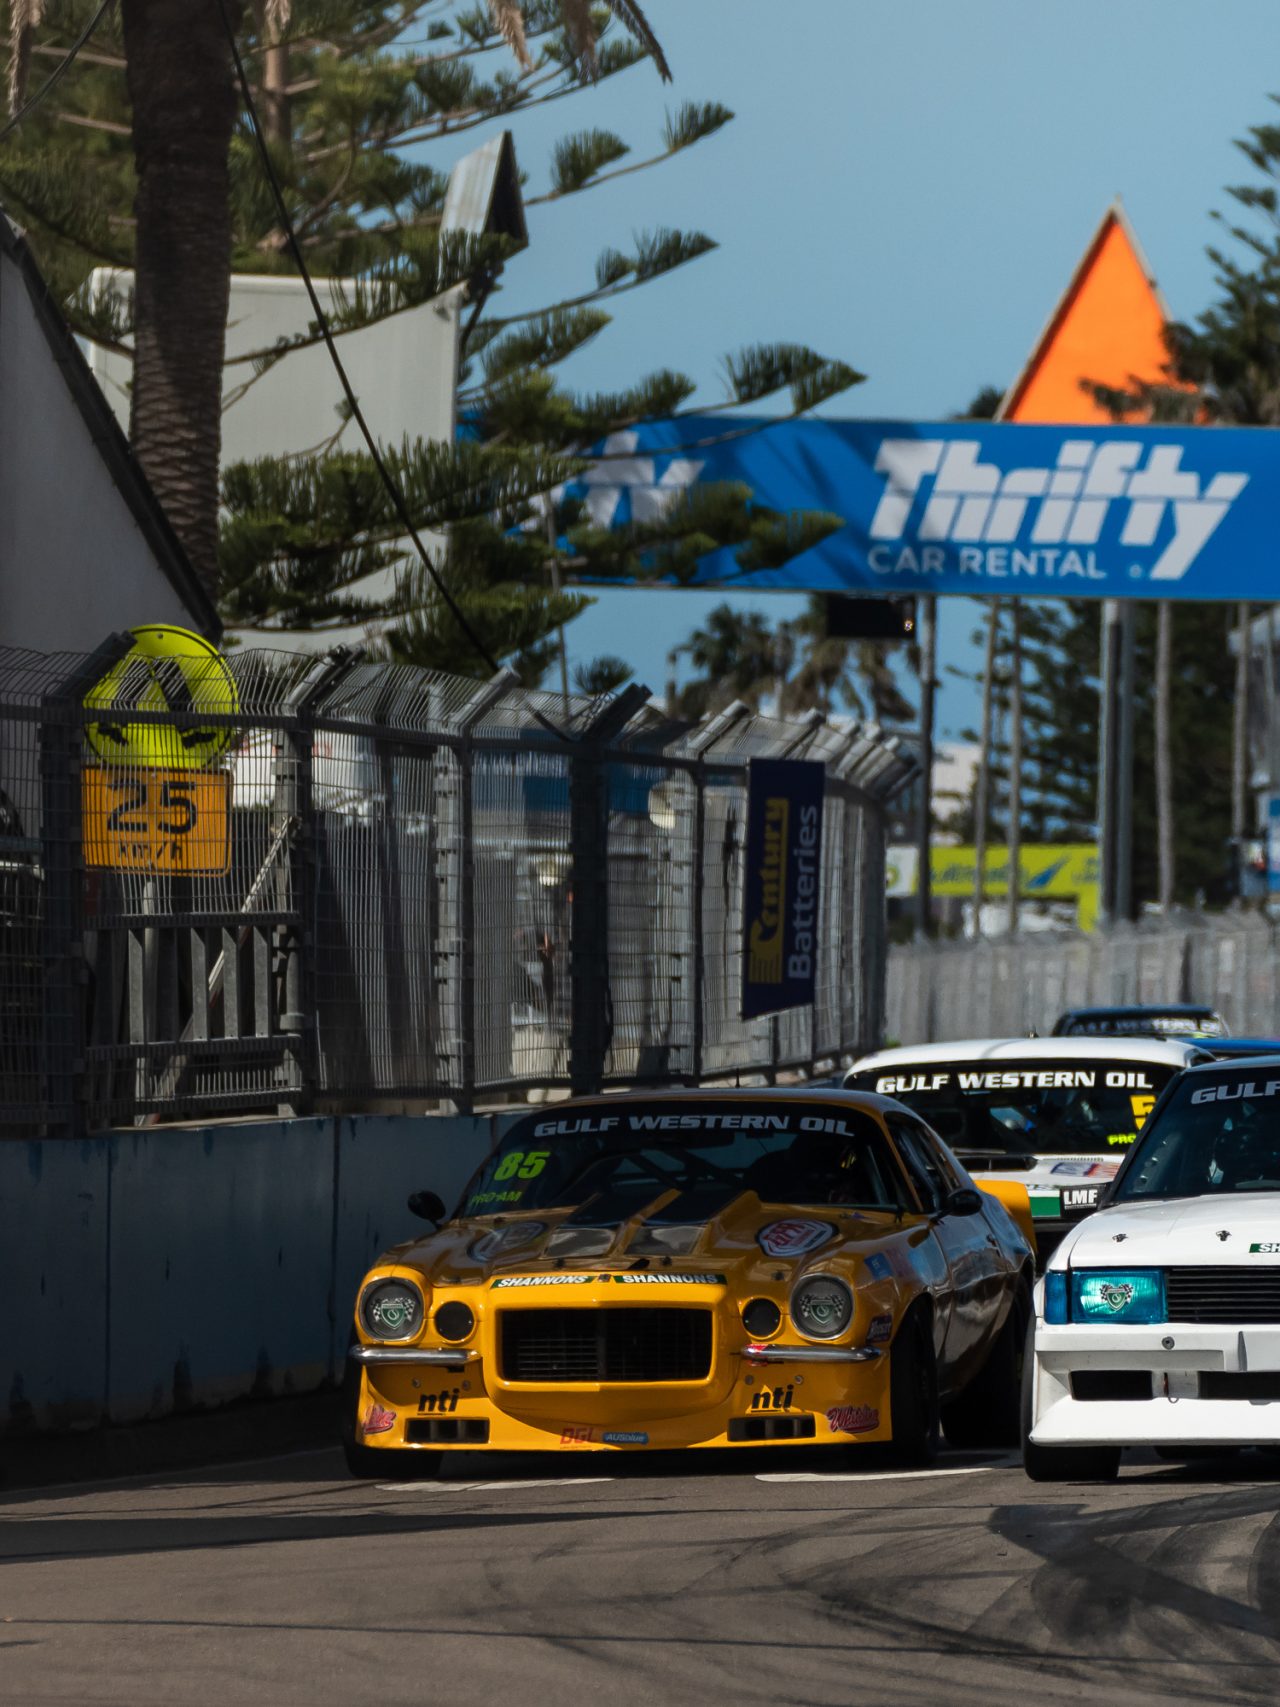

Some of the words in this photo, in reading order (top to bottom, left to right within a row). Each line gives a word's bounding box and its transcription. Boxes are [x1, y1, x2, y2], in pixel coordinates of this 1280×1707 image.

[869, 440, 1250, 580] Thrifty
[867, 546, 945, 575] CAR
[959, 546, 1107, 579] RENTAL
[107, 778, 198, 835] 25
[788, 804, 818, 979] Batteries
[875, 1074, 950, 1094] GULF
[958, 1071, 1096, 1089] WESTERN
[1105, 1071, 1153, 1089] OIL
[534, 1117, 620, 1138] GULF
[629, 1114, 790, 1131] WESTERN
[800, 1116, 855, 1137] OIL
[494, 1151, 551, 1181] 85
[1063, 1189, 1098, 1205] LMF
[498, 1275, 589, 1288] SHANNONS
[622, 1274, 719, 1284] SHANNONS
[418, 1388, 461, 1412] nti
[751, 1384, 794, 1409] nti
